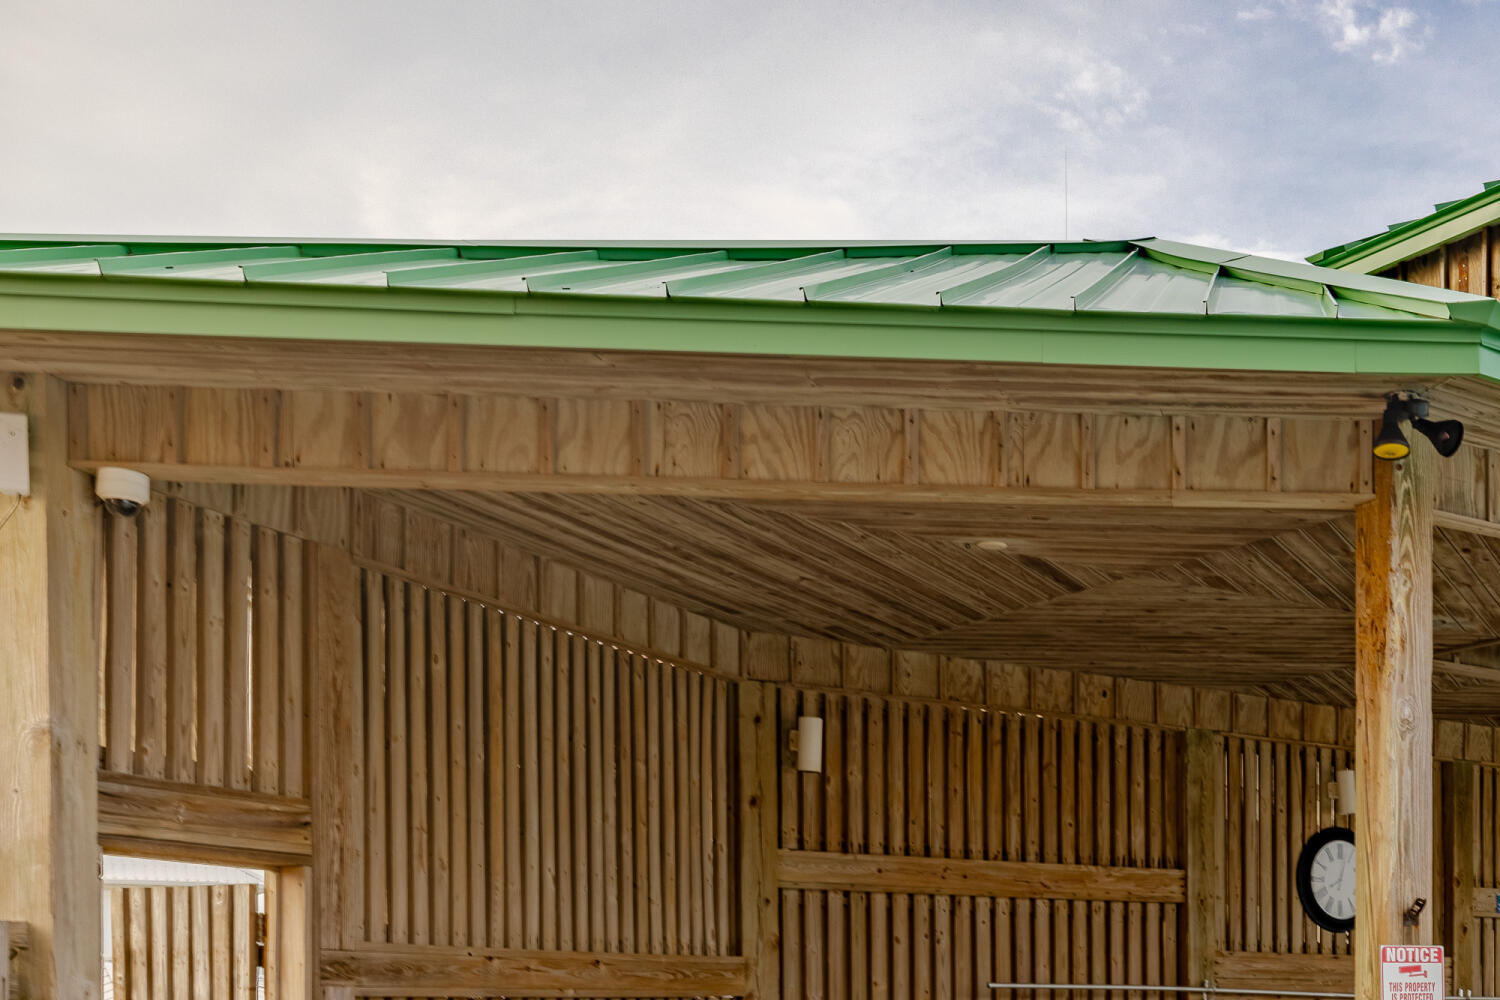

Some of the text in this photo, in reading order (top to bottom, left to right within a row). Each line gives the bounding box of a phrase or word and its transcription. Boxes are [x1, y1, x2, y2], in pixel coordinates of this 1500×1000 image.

[1386, 948, 1439, 962] NOTICE
[1389, 982, 1435, 992] THIS PROPERTY
